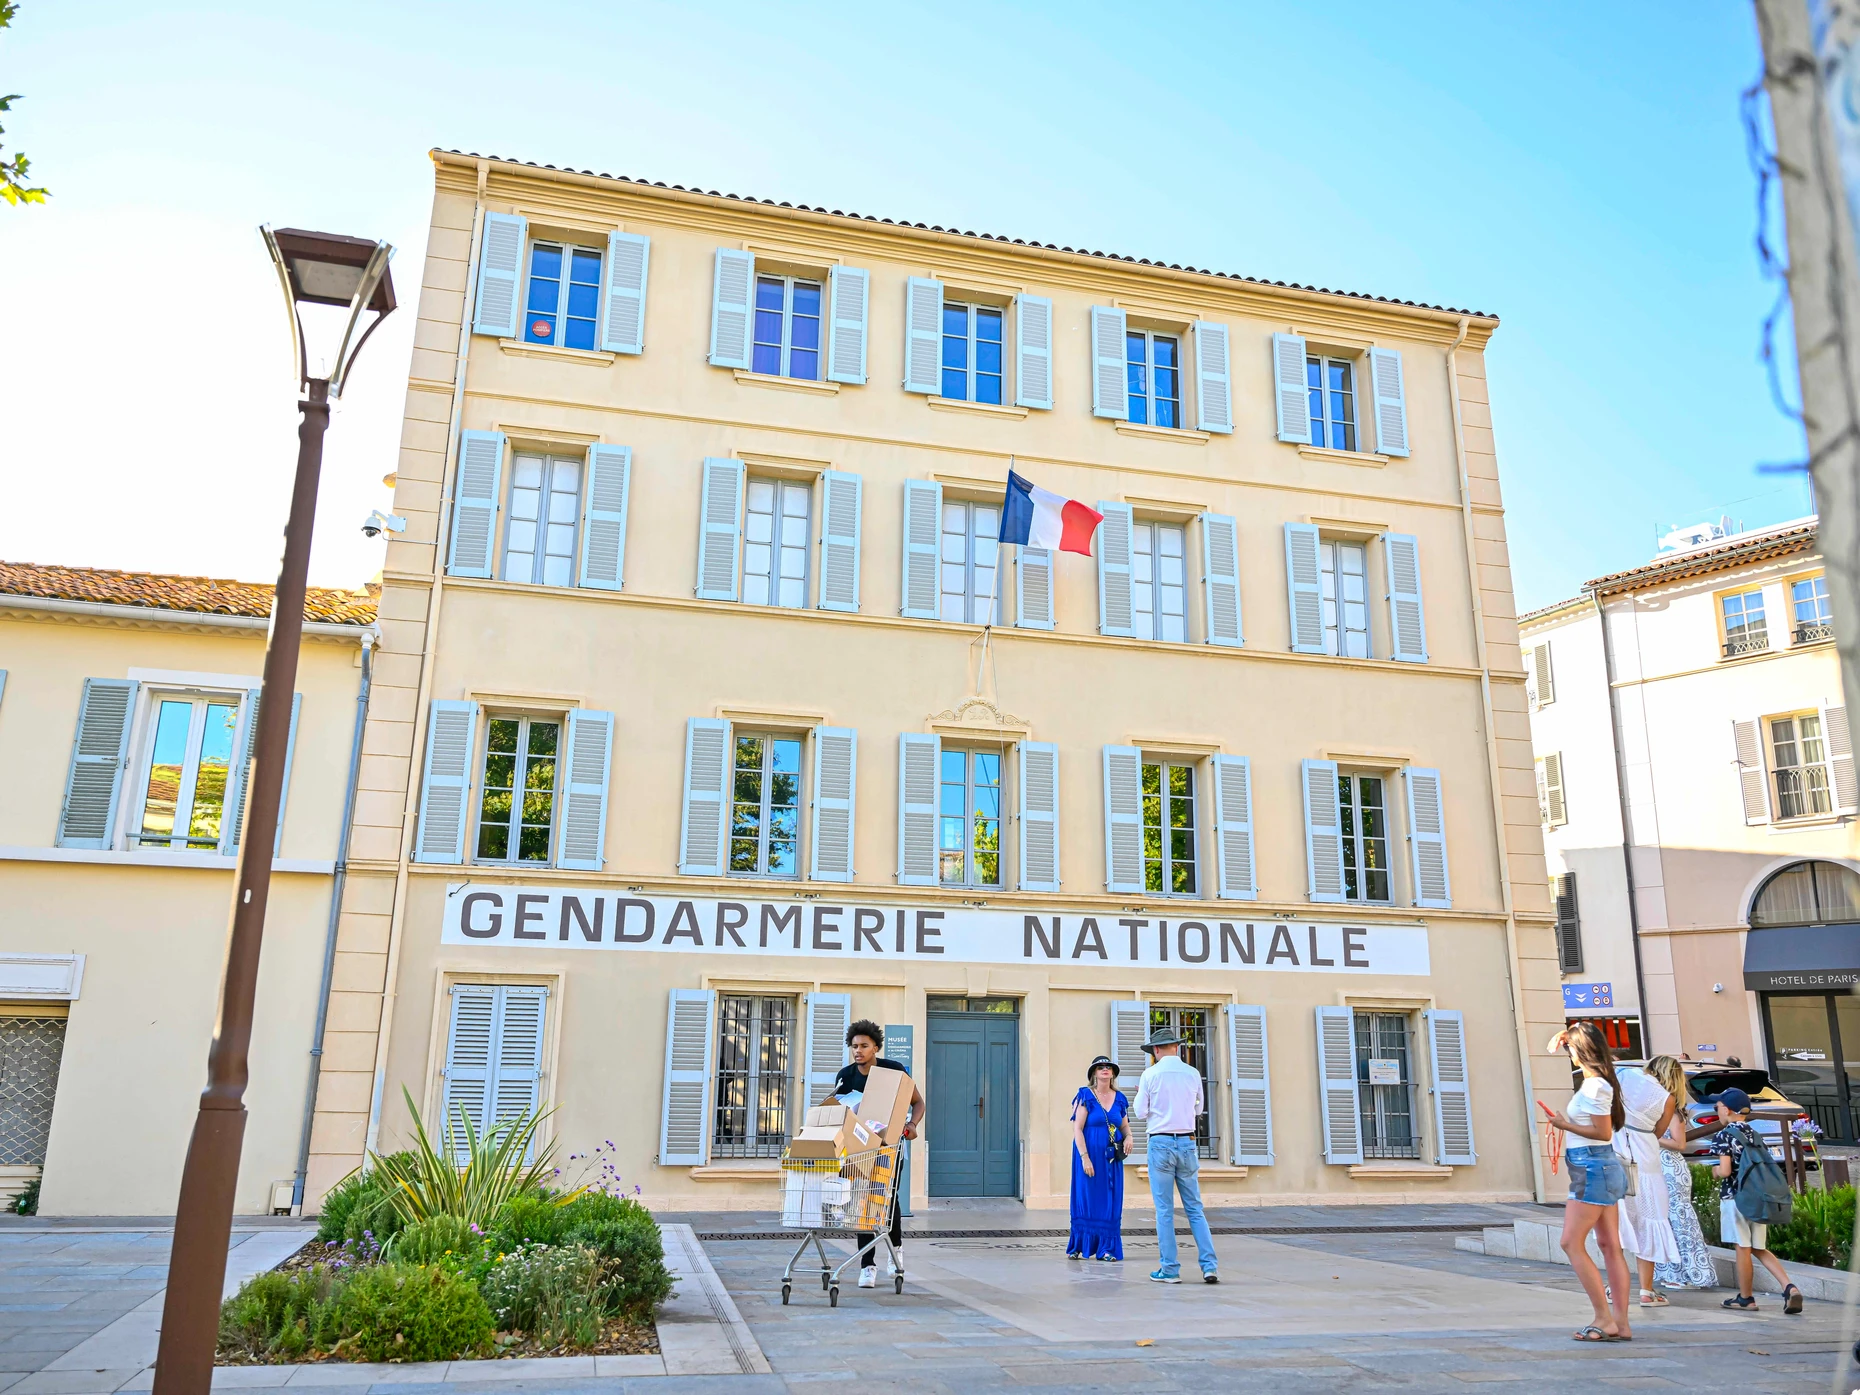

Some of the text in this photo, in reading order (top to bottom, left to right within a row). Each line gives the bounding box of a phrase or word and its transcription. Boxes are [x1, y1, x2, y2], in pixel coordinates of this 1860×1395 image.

[461, 892, 1370, 968] GENDARMERIE NATIONALE
[1770, 974, 1859, 985] HOTEL DE PARIS
